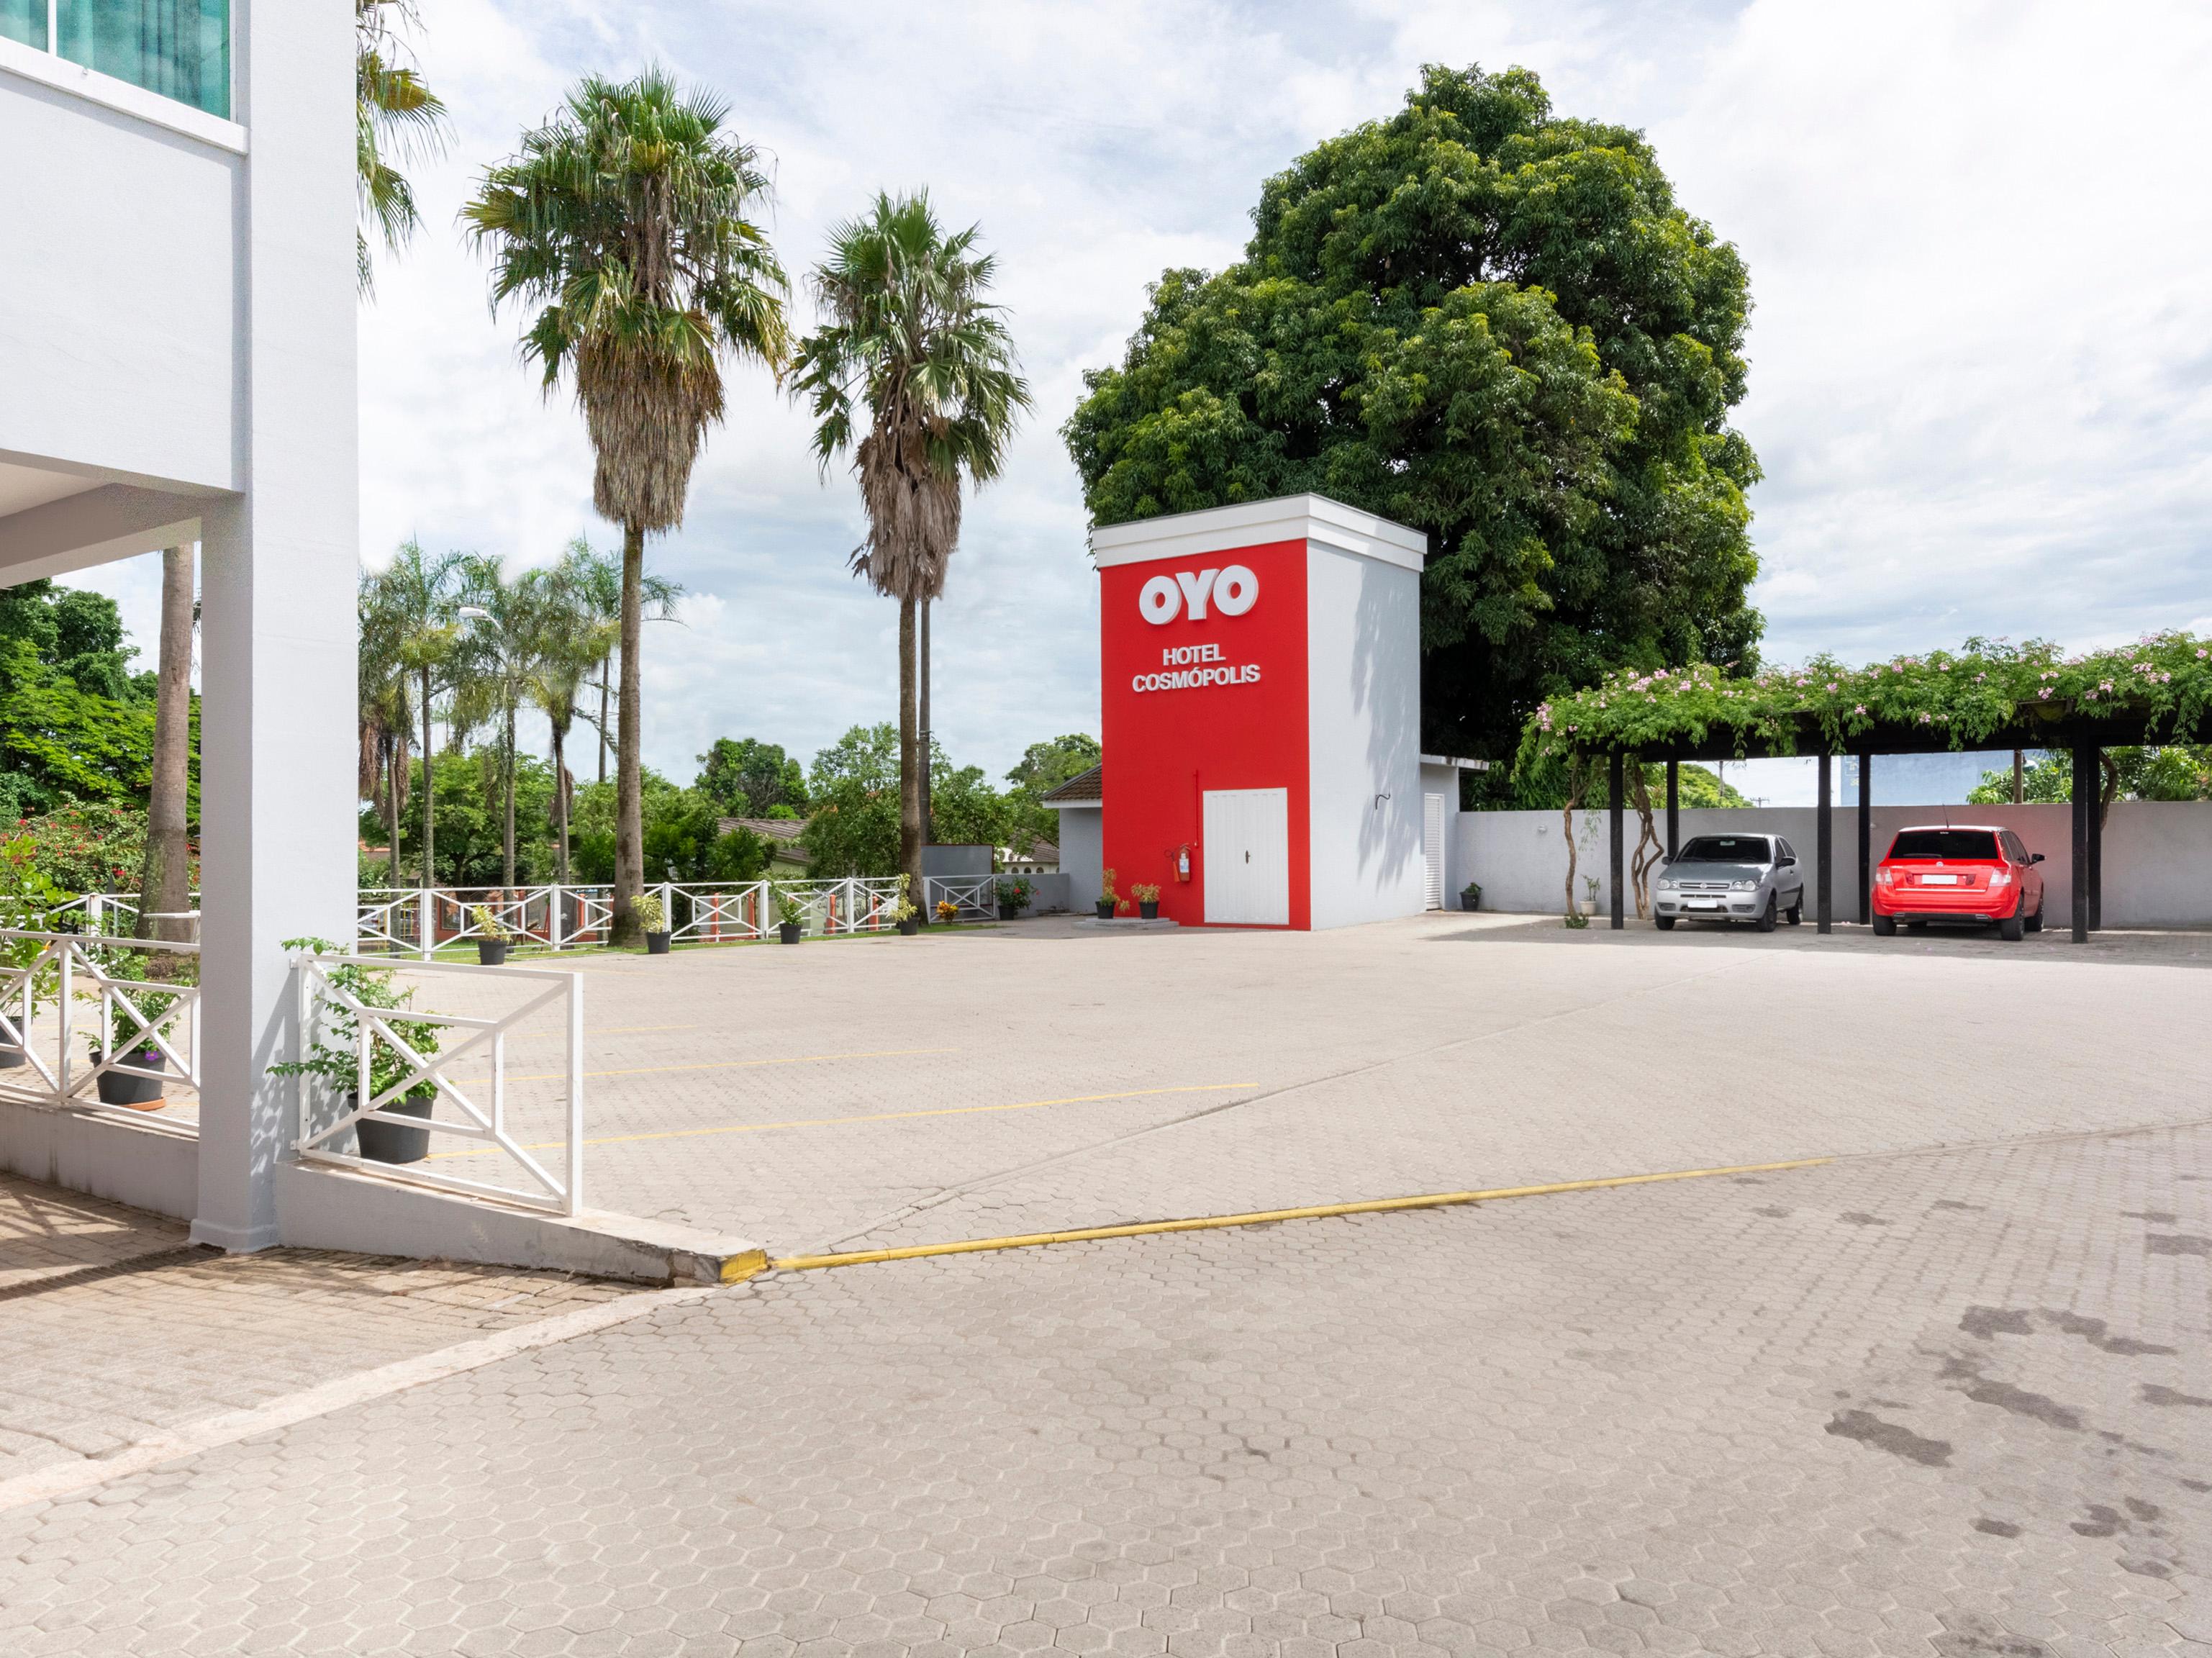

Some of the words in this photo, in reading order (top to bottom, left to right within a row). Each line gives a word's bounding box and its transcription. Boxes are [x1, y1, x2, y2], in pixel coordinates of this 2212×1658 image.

[1139, 565, 1259, 625] OYO
[1163, 643, 1226, 666] HOTEL
[1132, 663, 1261, 692] COSMÓPOLIS
